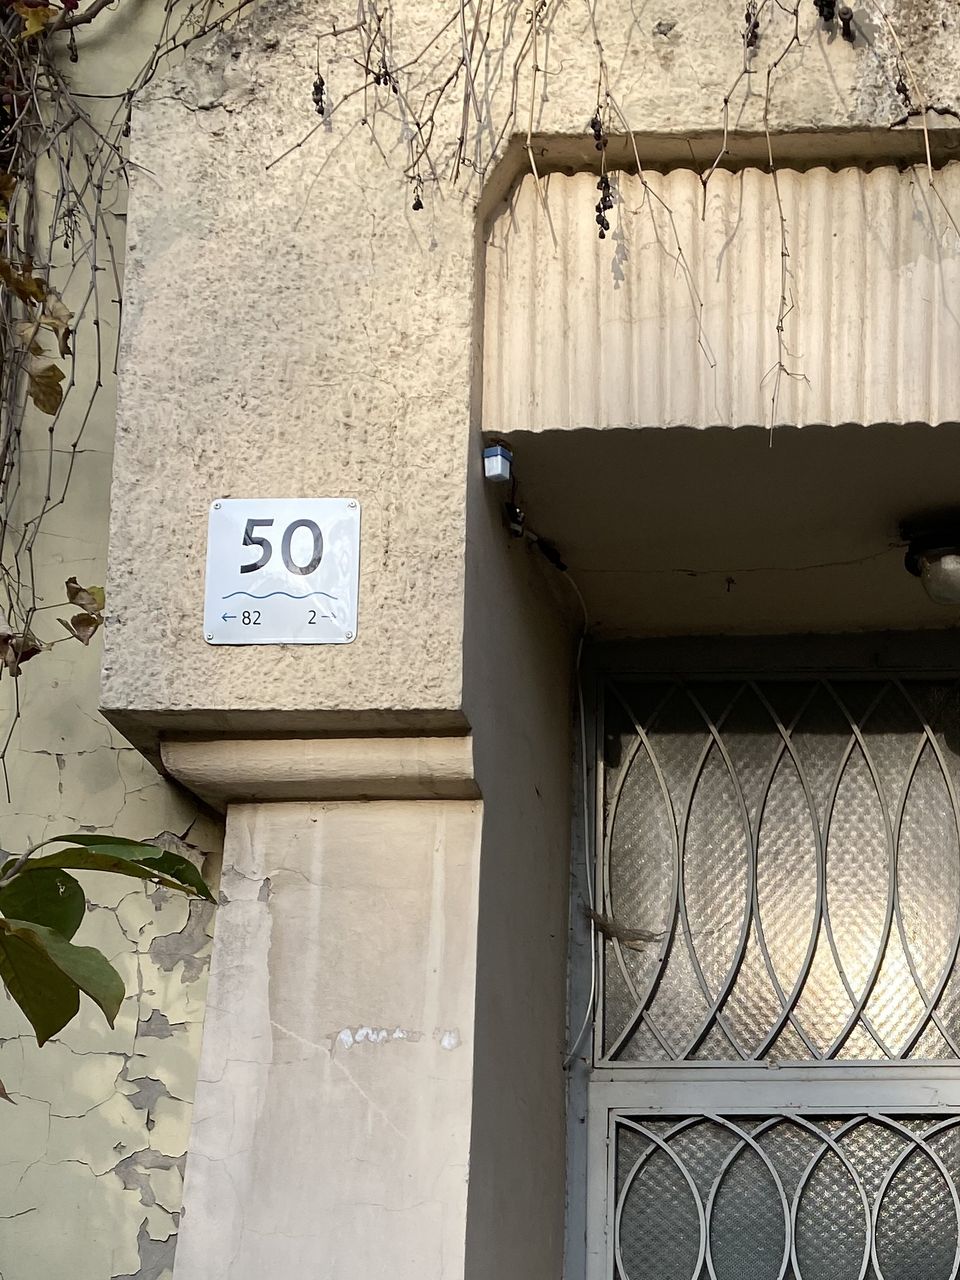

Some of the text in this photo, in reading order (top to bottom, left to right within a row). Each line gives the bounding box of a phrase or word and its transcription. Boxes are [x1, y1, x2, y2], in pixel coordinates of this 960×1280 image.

[240, 518, 324, 576] 50
[241, 609, 317, 625] 82 2
